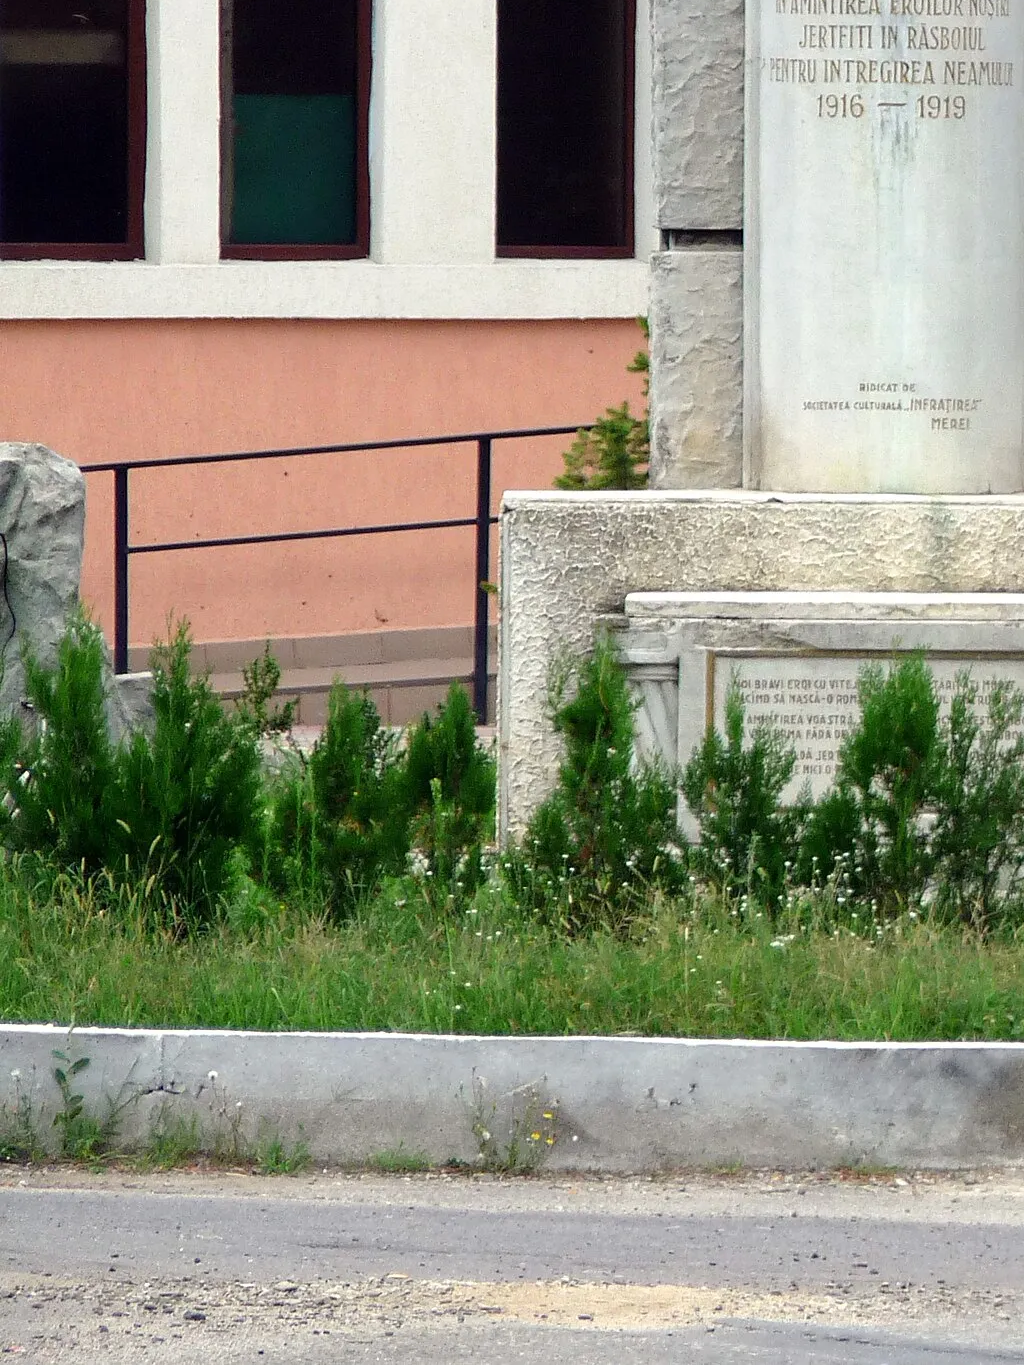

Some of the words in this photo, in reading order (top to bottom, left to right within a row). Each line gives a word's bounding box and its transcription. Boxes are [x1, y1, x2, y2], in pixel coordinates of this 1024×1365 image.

[823, 59, 936, 85] INTREGIREA
[817, 93, 865, 119] 1916
[917, 94, 966, 120] 1919
